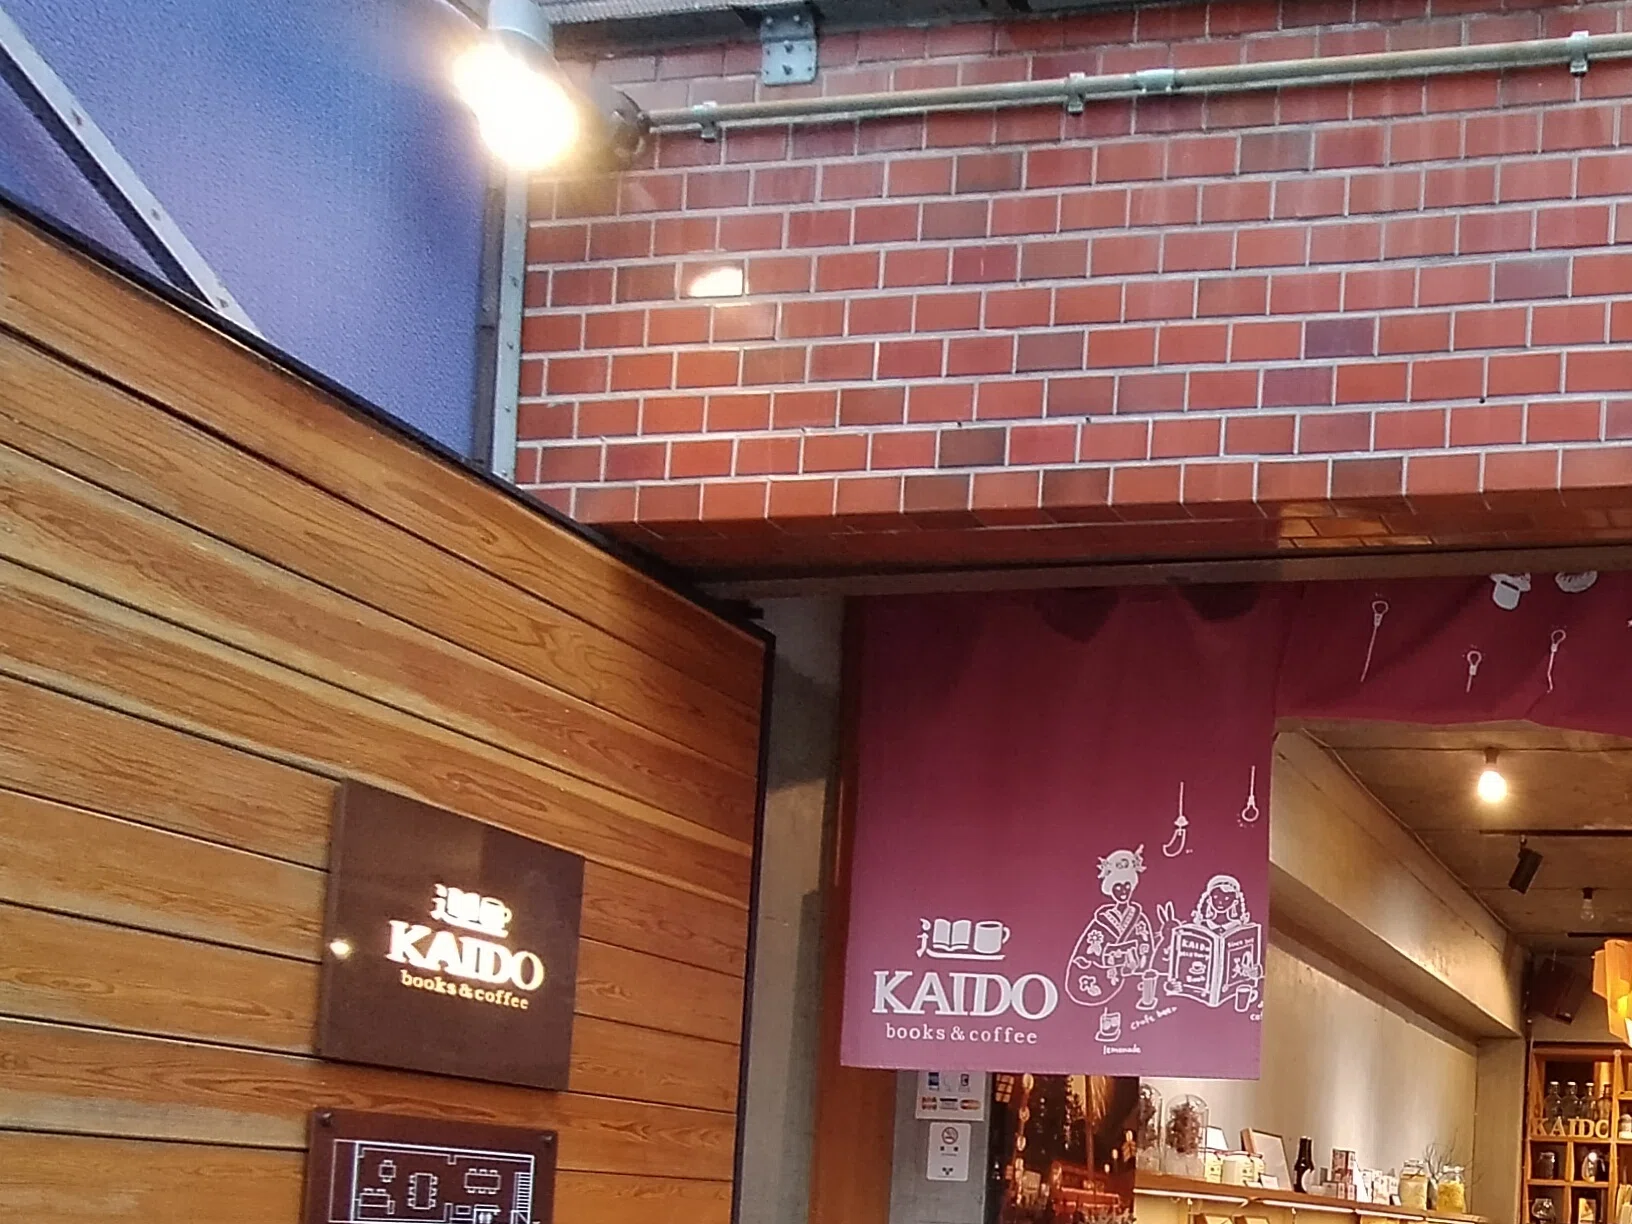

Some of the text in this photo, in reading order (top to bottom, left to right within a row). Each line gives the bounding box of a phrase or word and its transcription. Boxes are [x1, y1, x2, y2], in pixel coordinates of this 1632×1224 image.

[385, 919, 545, 991] KAIDO
[872, 970, 1059, 1020] KAIDO
[1103, 1044, 1142, 1055] lemonade
